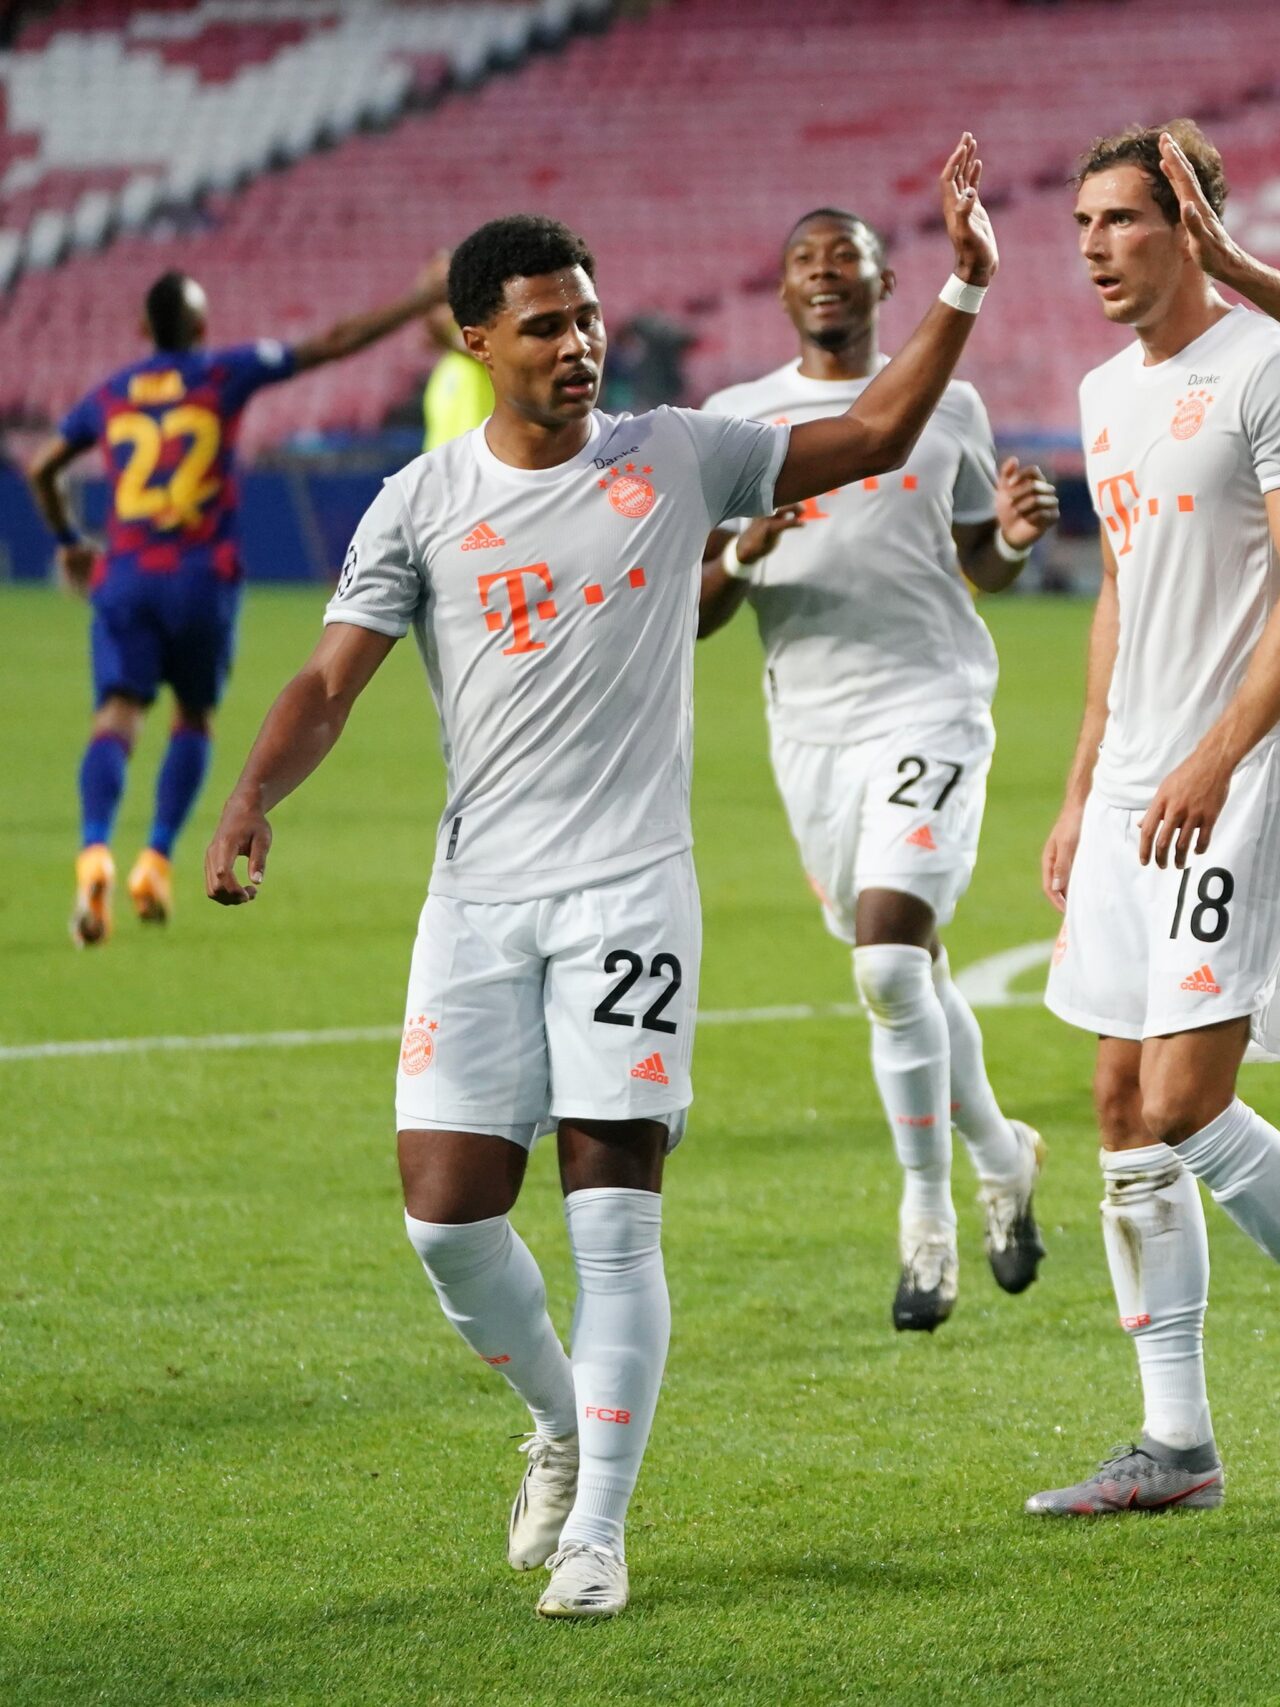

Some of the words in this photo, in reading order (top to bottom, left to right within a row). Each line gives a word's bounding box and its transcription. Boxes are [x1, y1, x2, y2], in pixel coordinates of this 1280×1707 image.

[1188, 374, 1220, 385] Danke
[107, 404, 220, 523] 22
[594, 446, 639, 470] Danke
[460, 537, 506, 551] adidas
[888, 755, 964, 811] 27
[1169, 867, 1234, 943] 18
[593, 949, 681, 1034] 22
[1180, 980, 1222, 994] adidas
[630, 1068, 669, 1085] adidas
[585, 1406, 631, 1424] FCB
